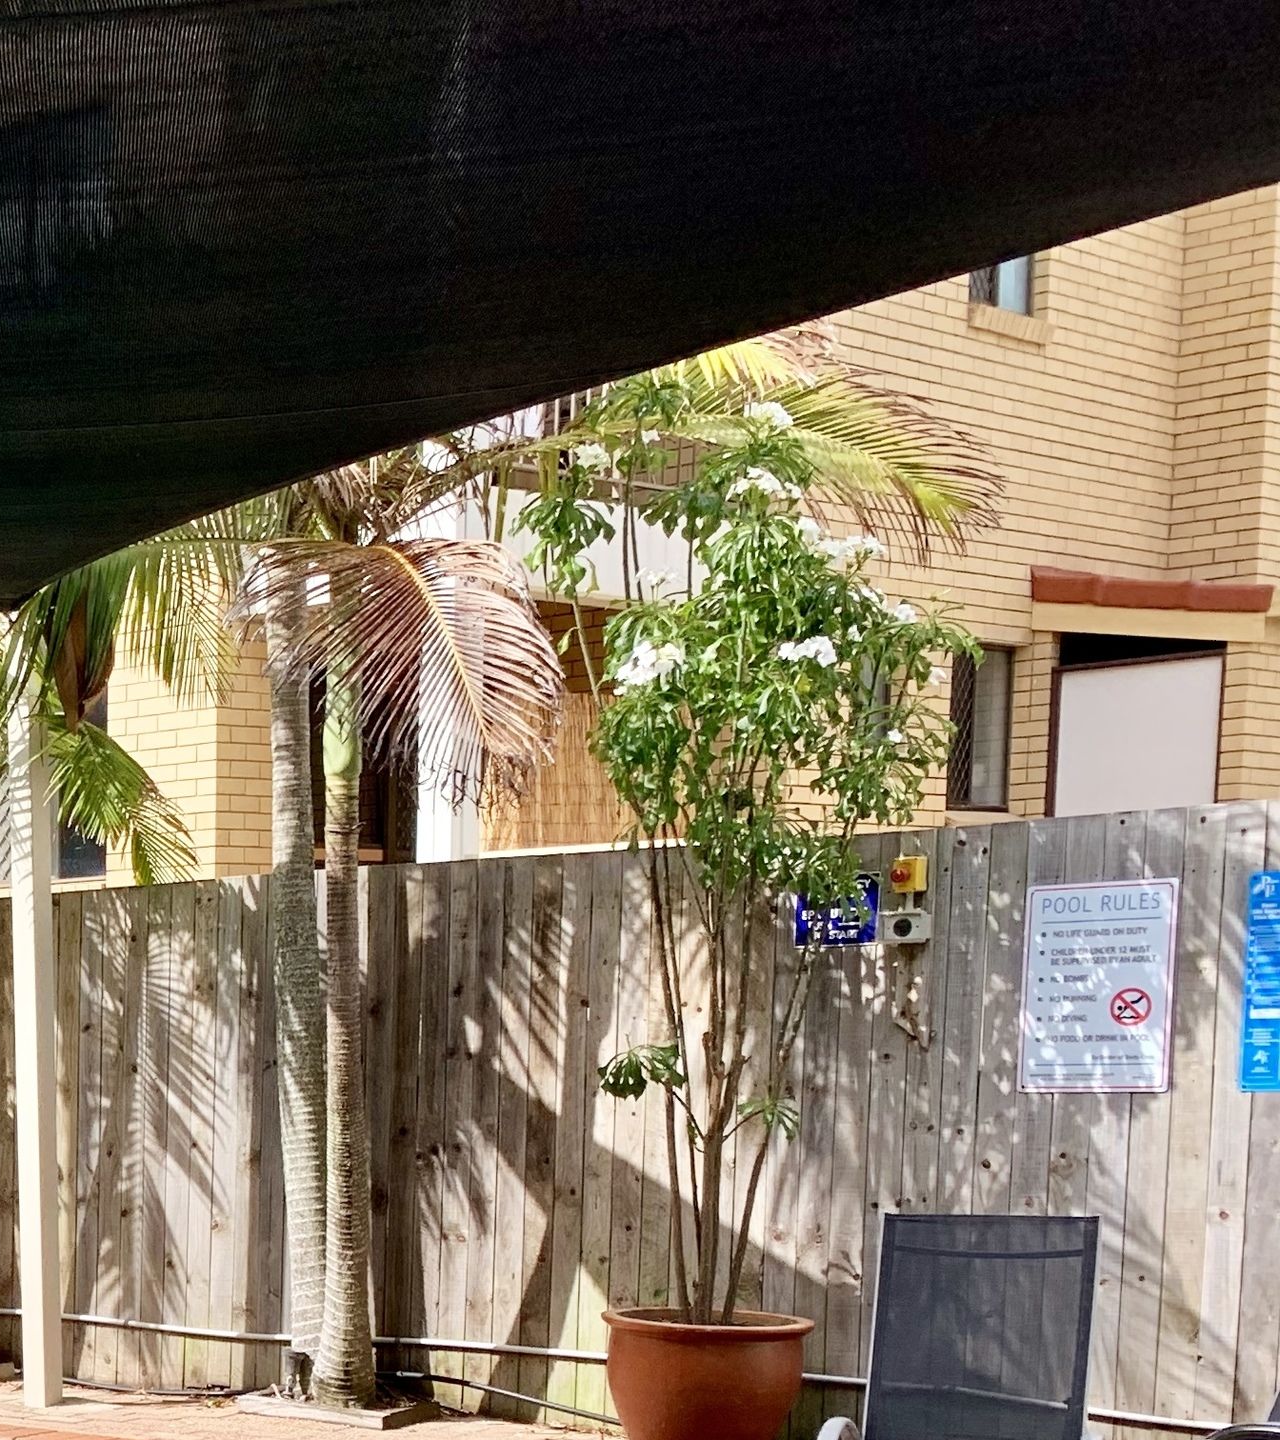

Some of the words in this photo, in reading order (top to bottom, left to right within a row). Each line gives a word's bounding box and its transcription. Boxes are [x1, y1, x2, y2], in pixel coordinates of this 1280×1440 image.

[1042, 897, 1093, 915] POOL
[1101, 892, 1161, 912] RULES
[828, 929, 859, 940] START
[1053, 930, 1065, 938] NO
[1066, 929, 1082, 938] LIFE
[1084, 928, 1110, 937] GUARD
[1113, 928, 1124, 936] ON
[1126, 927, 1148, 935] DUTY
[1090, 946, 1116, 955] UNDER
[1118, 946, 1127, 954] 12
[1129, 945, 1151, 953] MUST
[1051, 958, 1060, 966] BE
[1062, 956, 1107, 965] SUPERVSED
[1109, 956, 1118, 964] BY
[1119, 955, 1131, 963] AN
[1132, 954, 1157, 963] ADULT
[1063, 994, 1097, 1002] RUNNING
[1048, 1015, 1060, 1023] NO
[1062, 1014, 1087, 1023] DIVING
[1060, 1035, 1081, 1043] FOOD
[1083, 1034, 1093, 1042] OR
[1095, 1034, 1118, 1042] DRINK
[1119, 1034, 1129, 1042] IN
